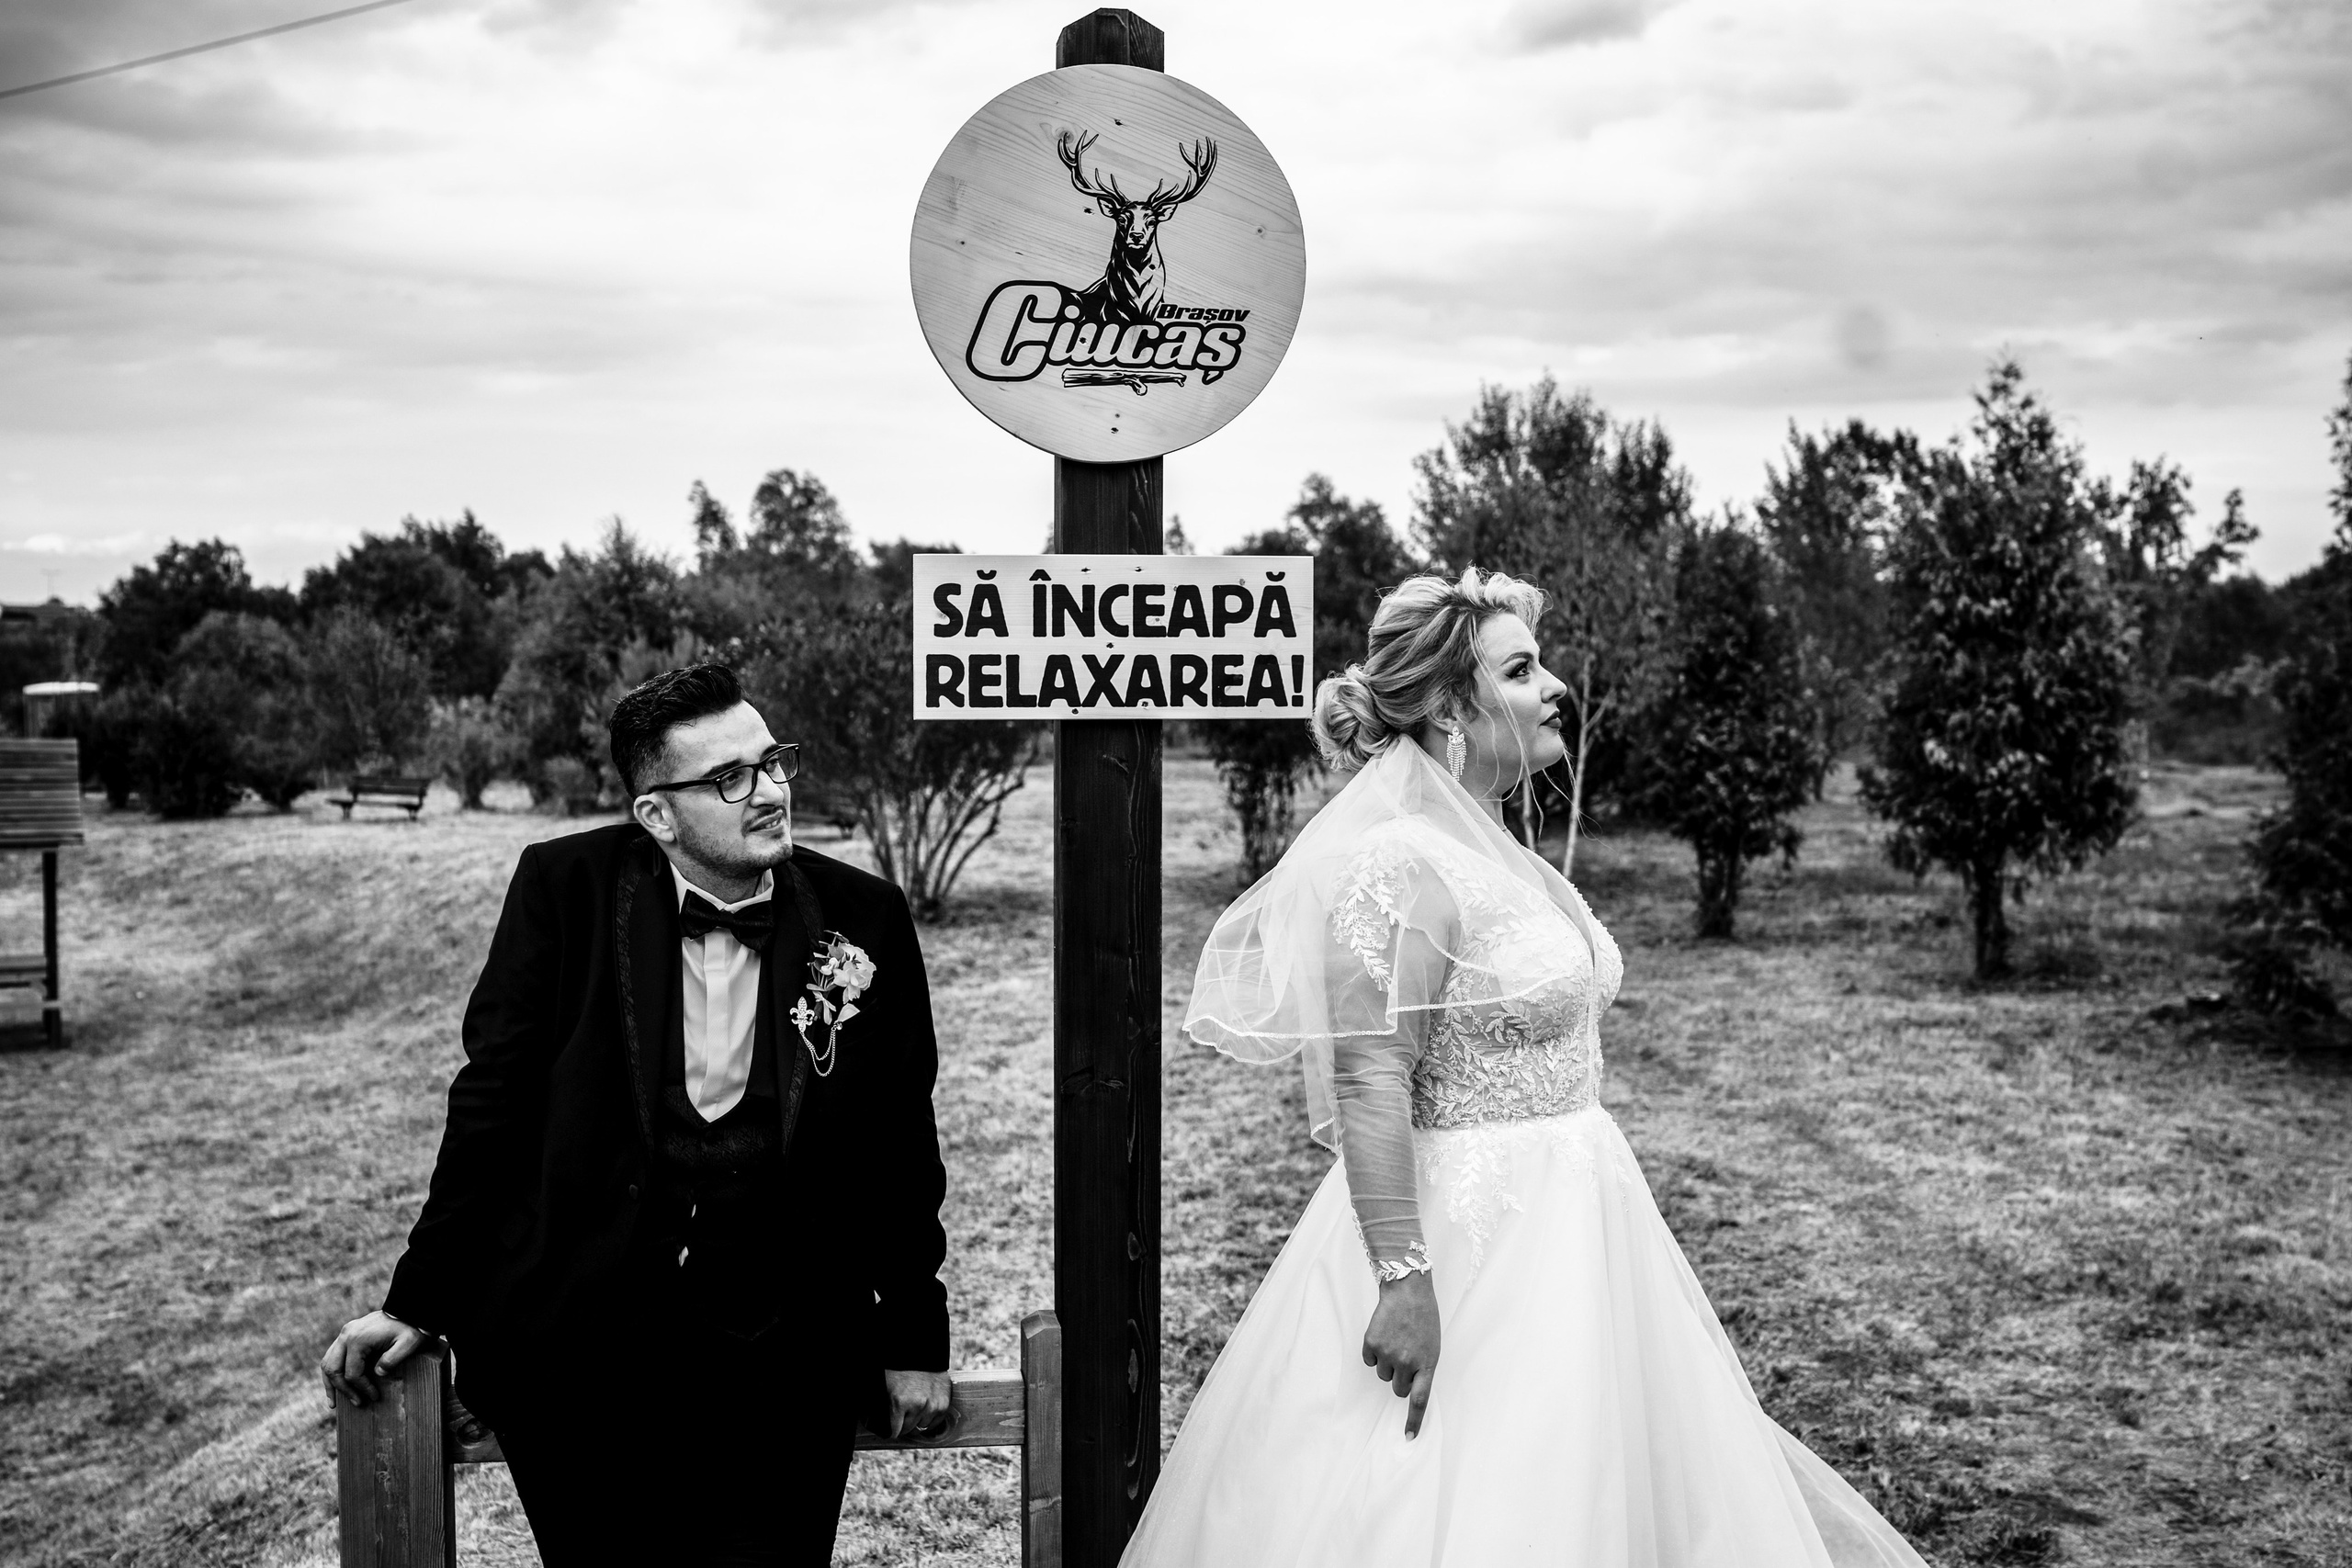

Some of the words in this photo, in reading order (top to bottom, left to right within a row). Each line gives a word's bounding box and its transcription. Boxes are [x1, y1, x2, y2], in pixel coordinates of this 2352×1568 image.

[965, 279, 1247, 385] Ciucaș
[1157, 303, 1251, 323] Brașov
[933, 569, 1010, 638] SĂ
[1028, 568, 1297, 638] ÎNCEAPĂ
[925, 653, 1305, 708] RELAXAREA!
